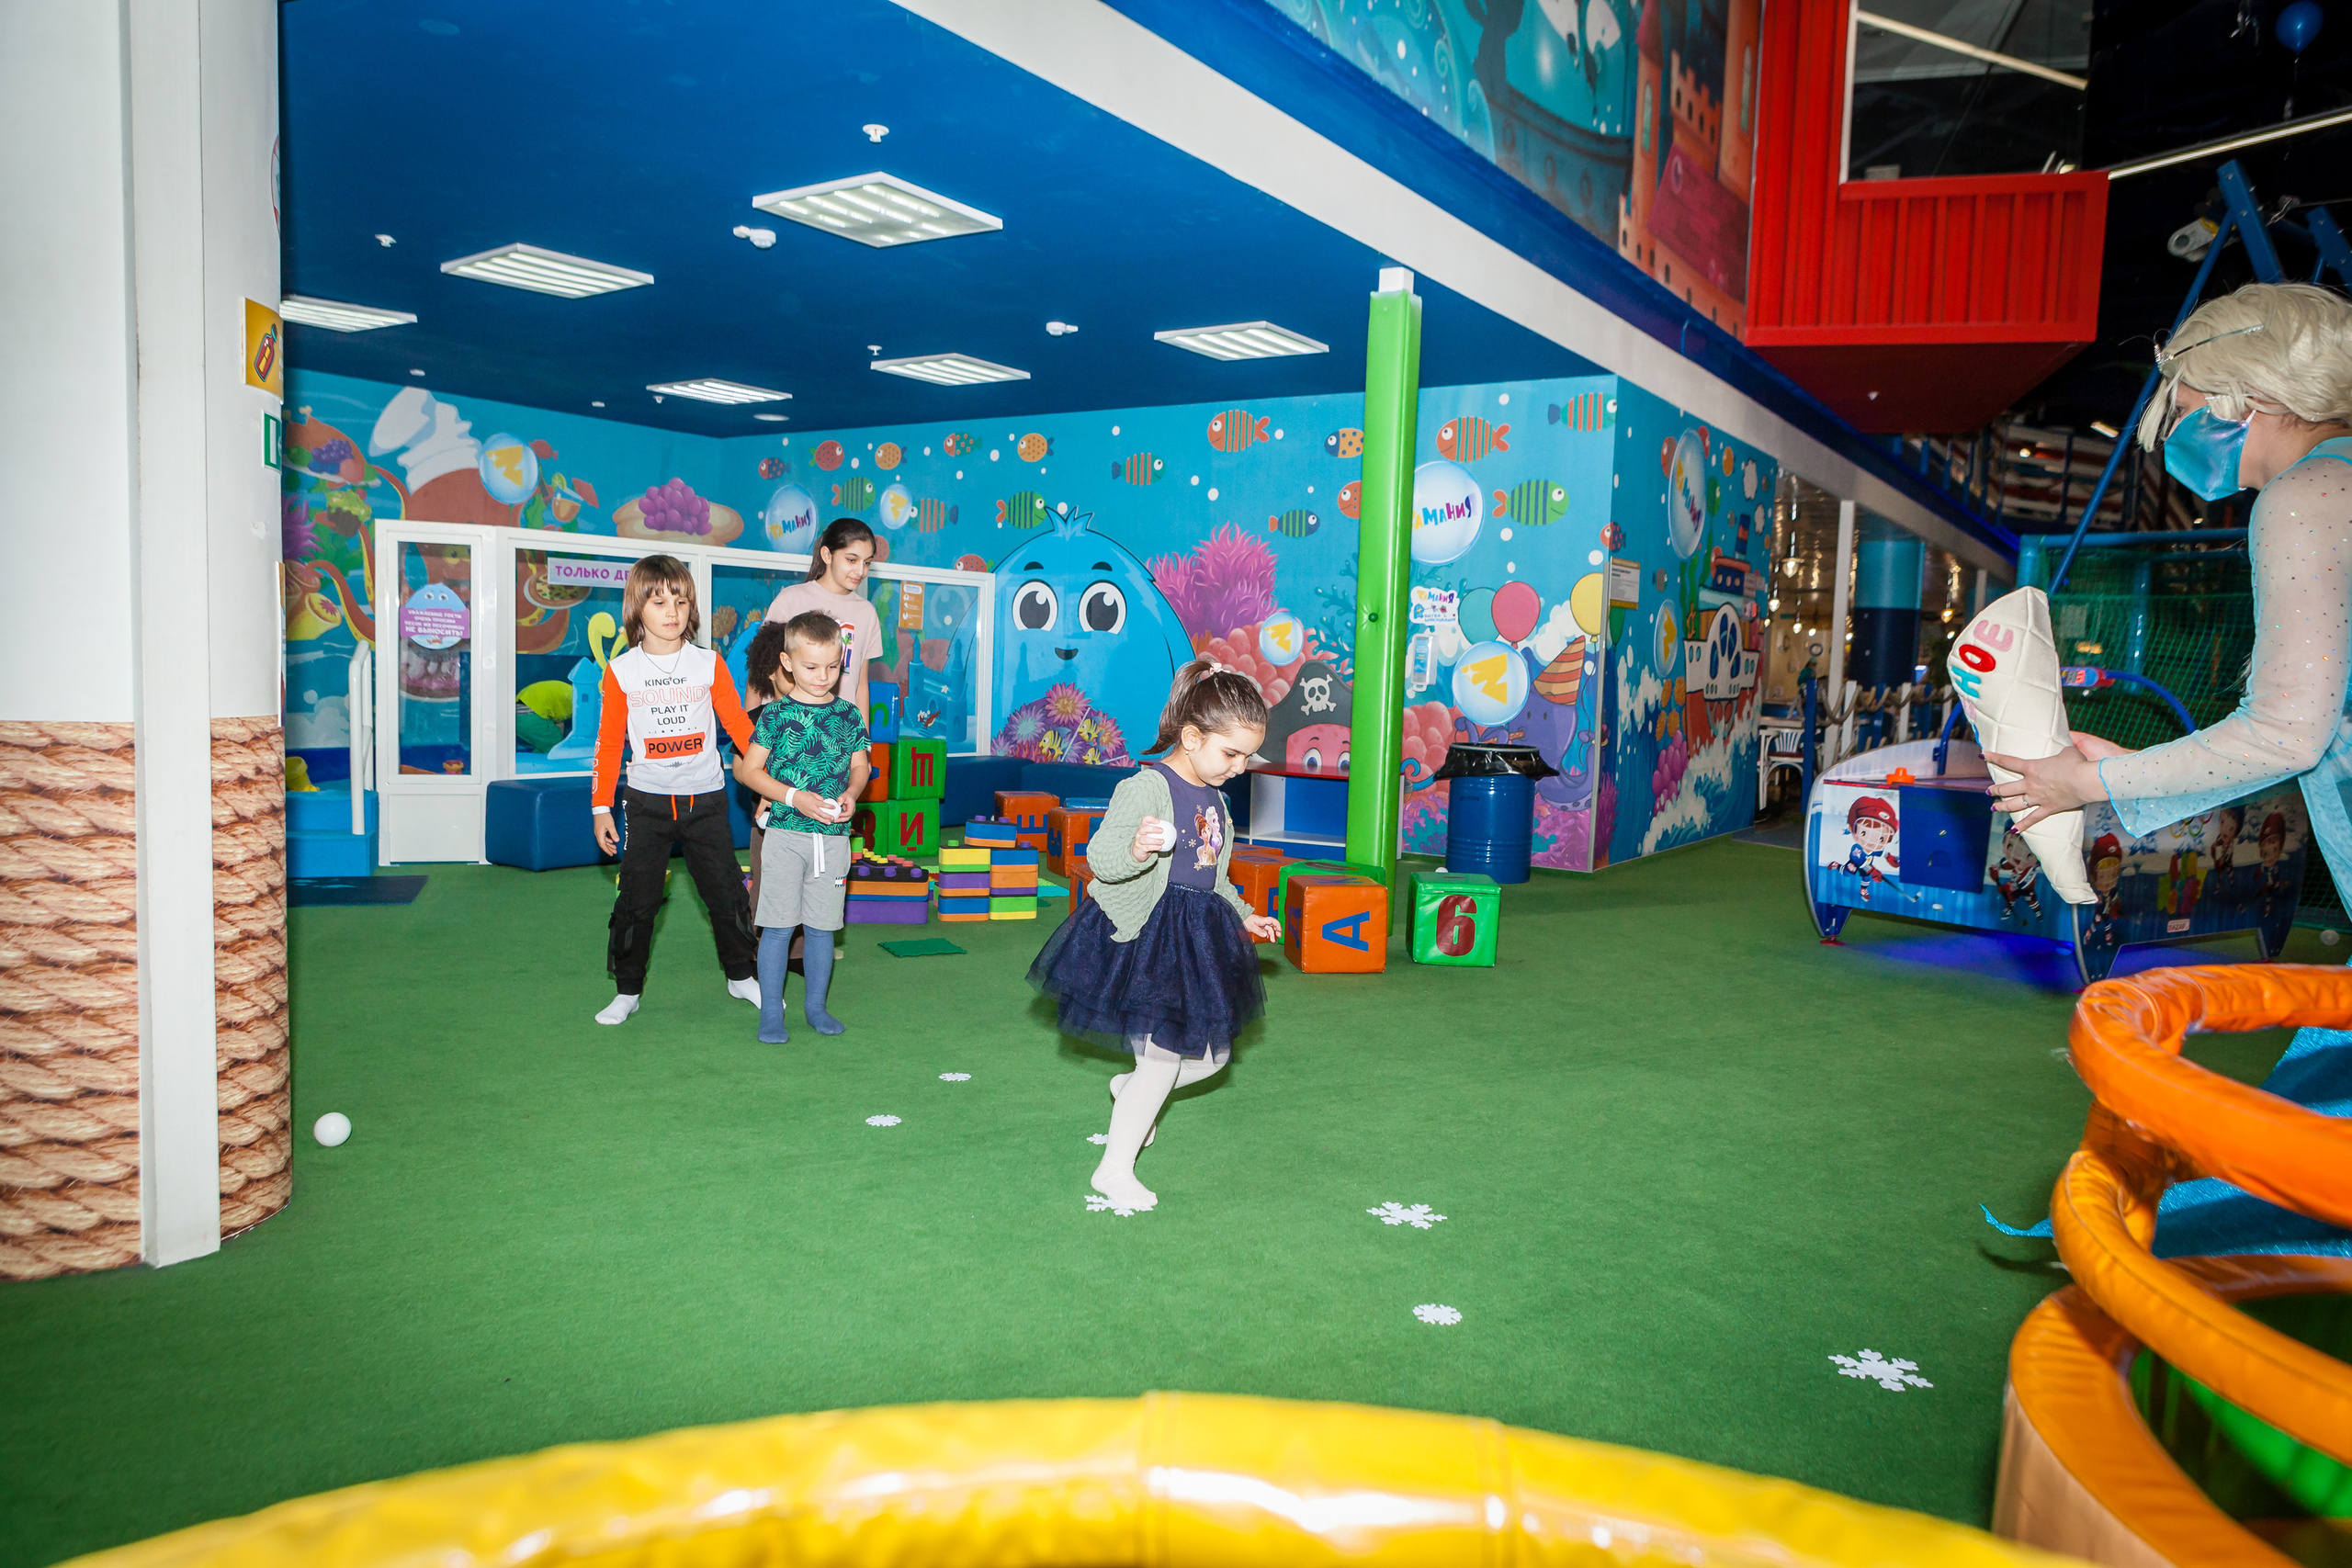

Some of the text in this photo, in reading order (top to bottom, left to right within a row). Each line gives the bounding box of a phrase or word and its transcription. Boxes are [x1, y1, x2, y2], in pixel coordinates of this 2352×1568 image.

[555, 565, 610, 580] ТОЛЬКО
[417, 627, 463, 637] ВЫНОСИТЬ!
[644, 677, 687, 687] KING OF
[628, 685, 707, 707] SOUND
[650, 705, 677, 715] PLAY
[657, 716, 686, 726] LOUD
[648, 738, 703, 754] POWER
